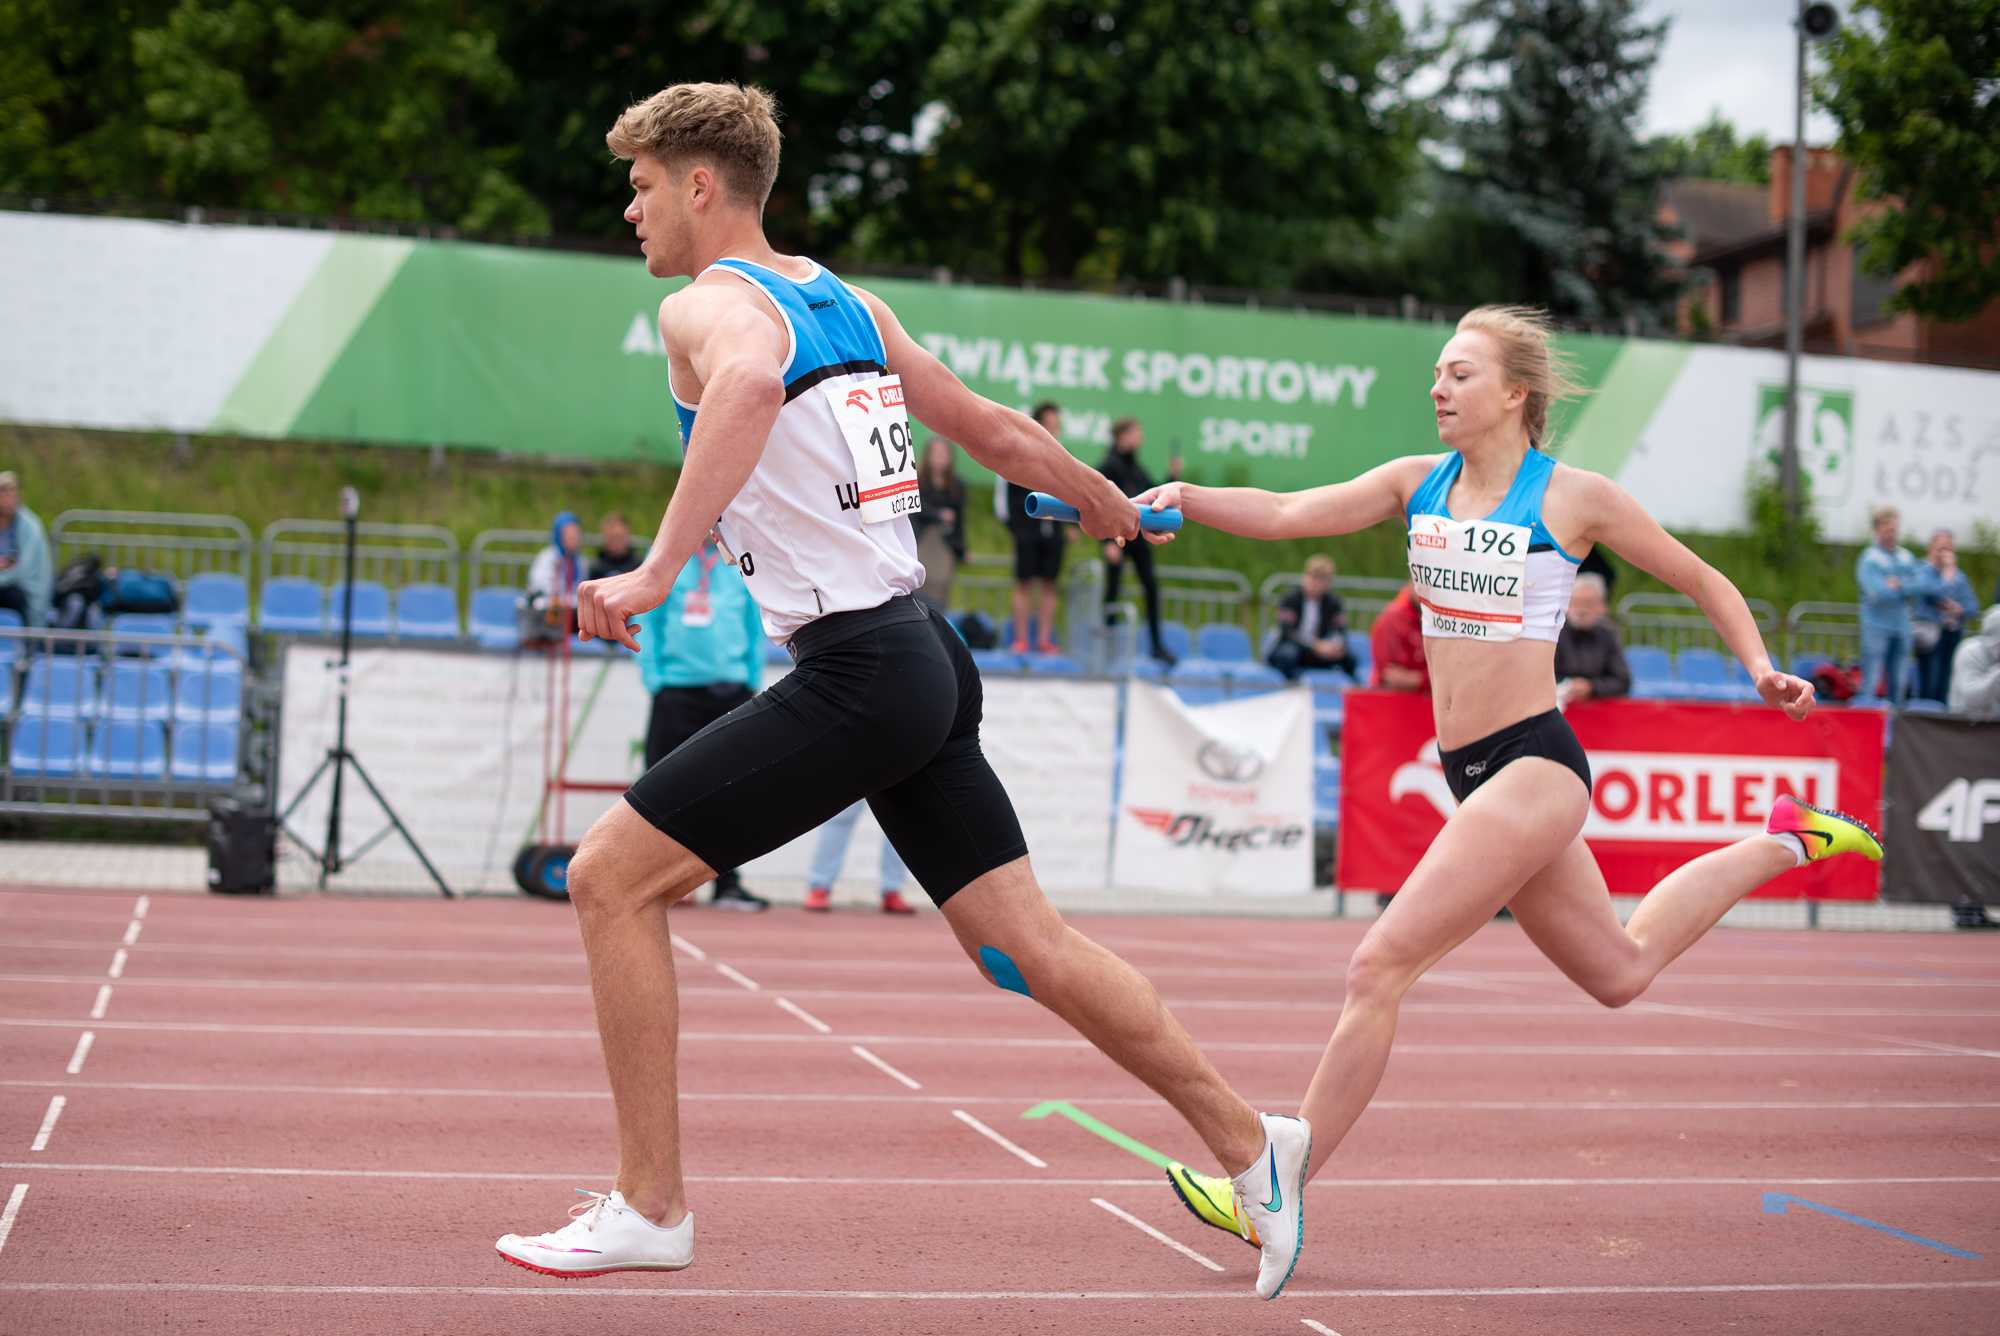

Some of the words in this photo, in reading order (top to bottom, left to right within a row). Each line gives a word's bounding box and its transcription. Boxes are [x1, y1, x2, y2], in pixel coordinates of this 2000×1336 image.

[881, 387, 904, 405] ORLE
[1121, 349, 1378, 409] SPORTOWY
[1199, 416, 1314, 459] SPORT
[1878, 410, 1963, 452] AZS
[1415, 534, 1446, 548] ORLEN
[1463, 526, 1516, 556] 196
[1410, 563, 1519, 597] STRZELEWICZ
[1433, 614, 1458, 633] ŁÓDŹ
[1460, 622, 1487, 637] 2021
[1916, 776, 2000, 842] 4F
